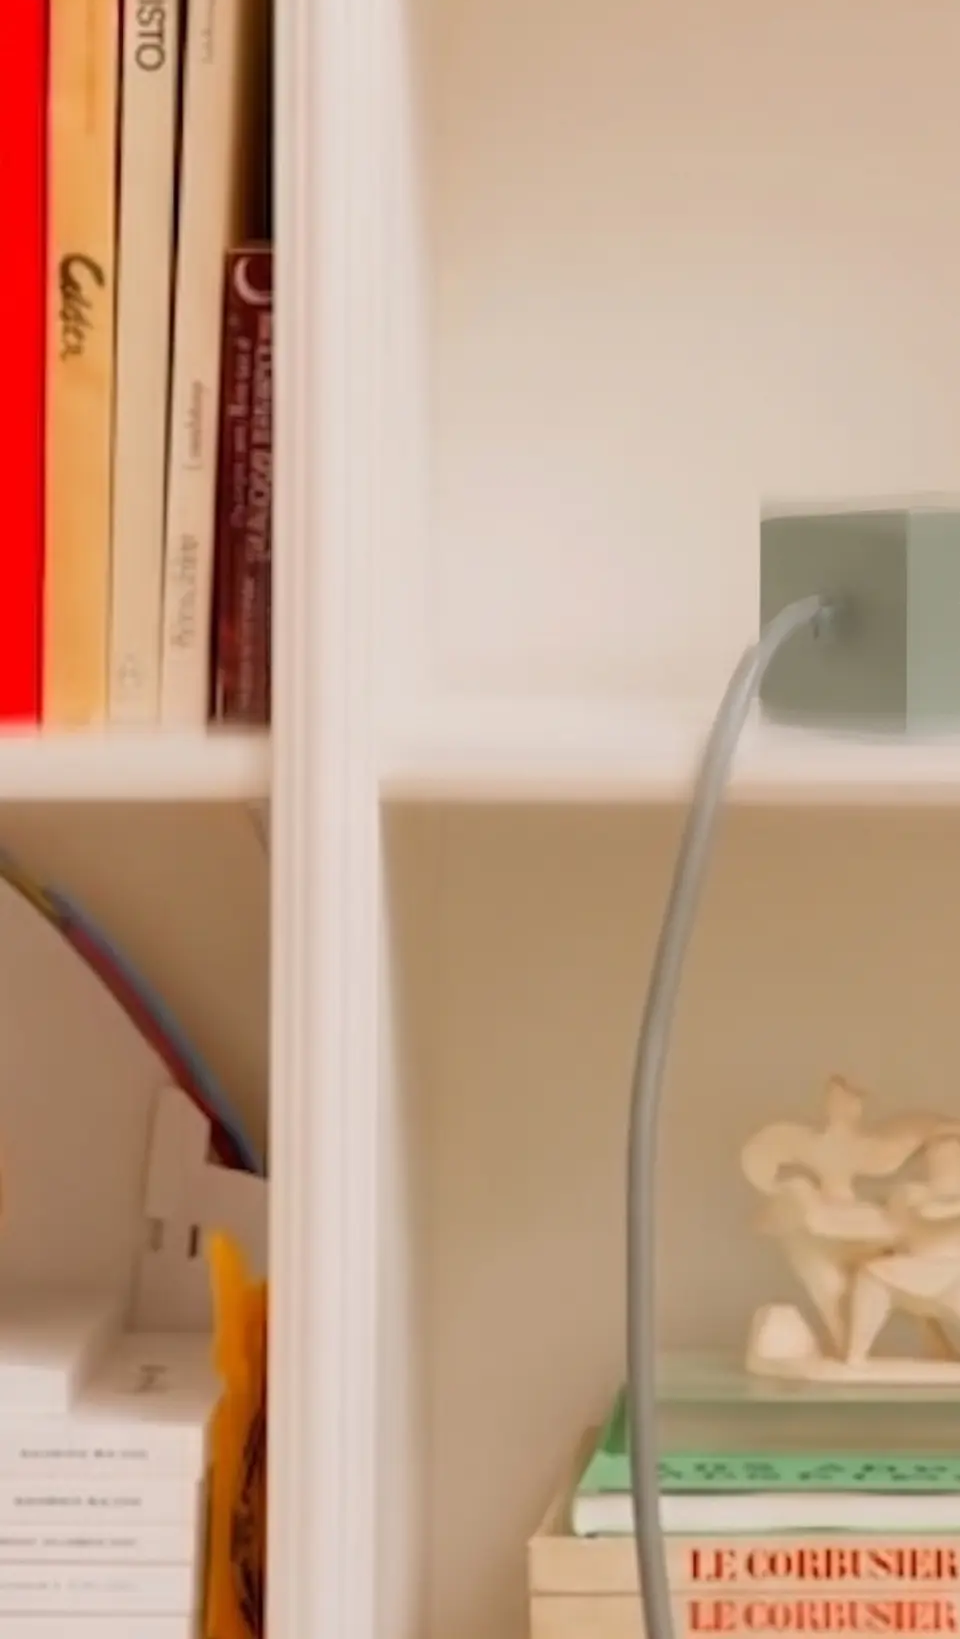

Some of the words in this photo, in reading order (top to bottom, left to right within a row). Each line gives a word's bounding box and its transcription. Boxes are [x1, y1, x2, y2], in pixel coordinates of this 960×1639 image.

[690, 1547, 739, 1583] LE
[745, 1547, 960, 1583] CORBUSIER
[686, 1598, 739, 1633] LE
[743, 1599, 959, 1633] CORBUSIER
